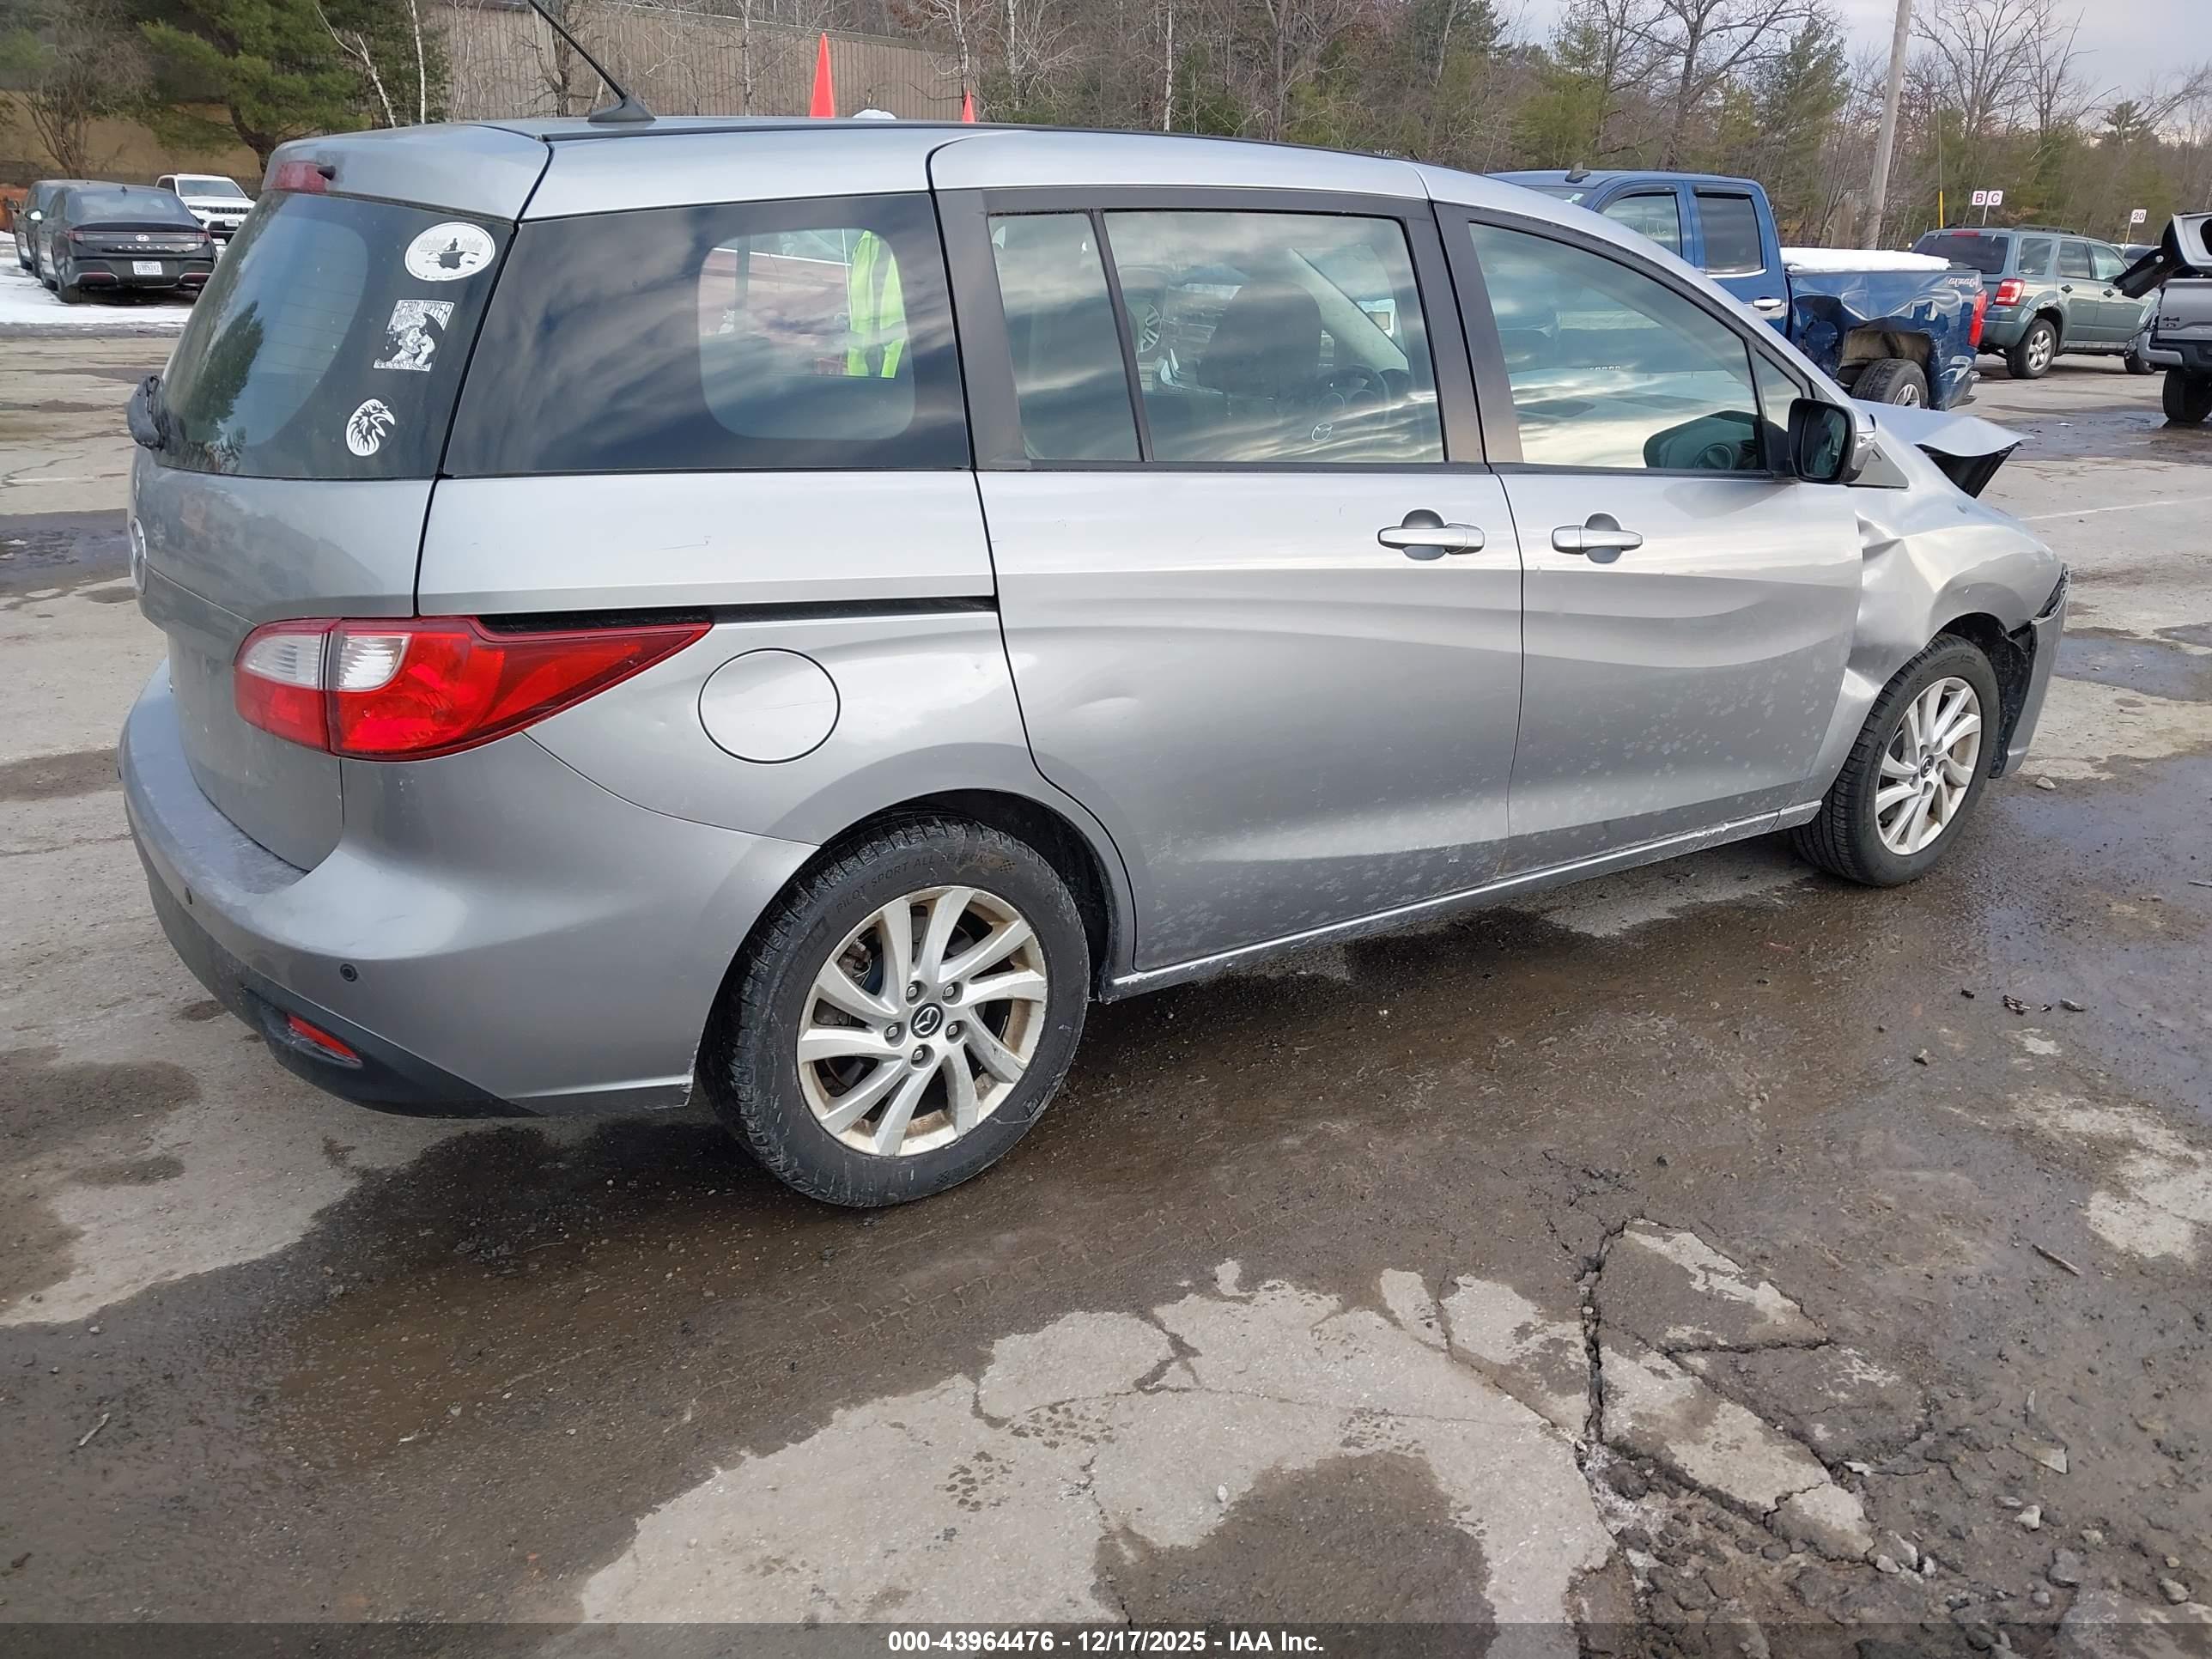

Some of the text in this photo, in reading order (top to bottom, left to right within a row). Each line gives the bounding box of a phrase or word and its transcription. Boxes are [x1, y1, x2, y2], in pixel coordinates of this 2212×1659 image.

[1975, 192, 1984, 204] B
[1991, 192, 2000, 204] C
[871, 860, 908, 887] SPORT
[914, 854, 935, 868] ALL
